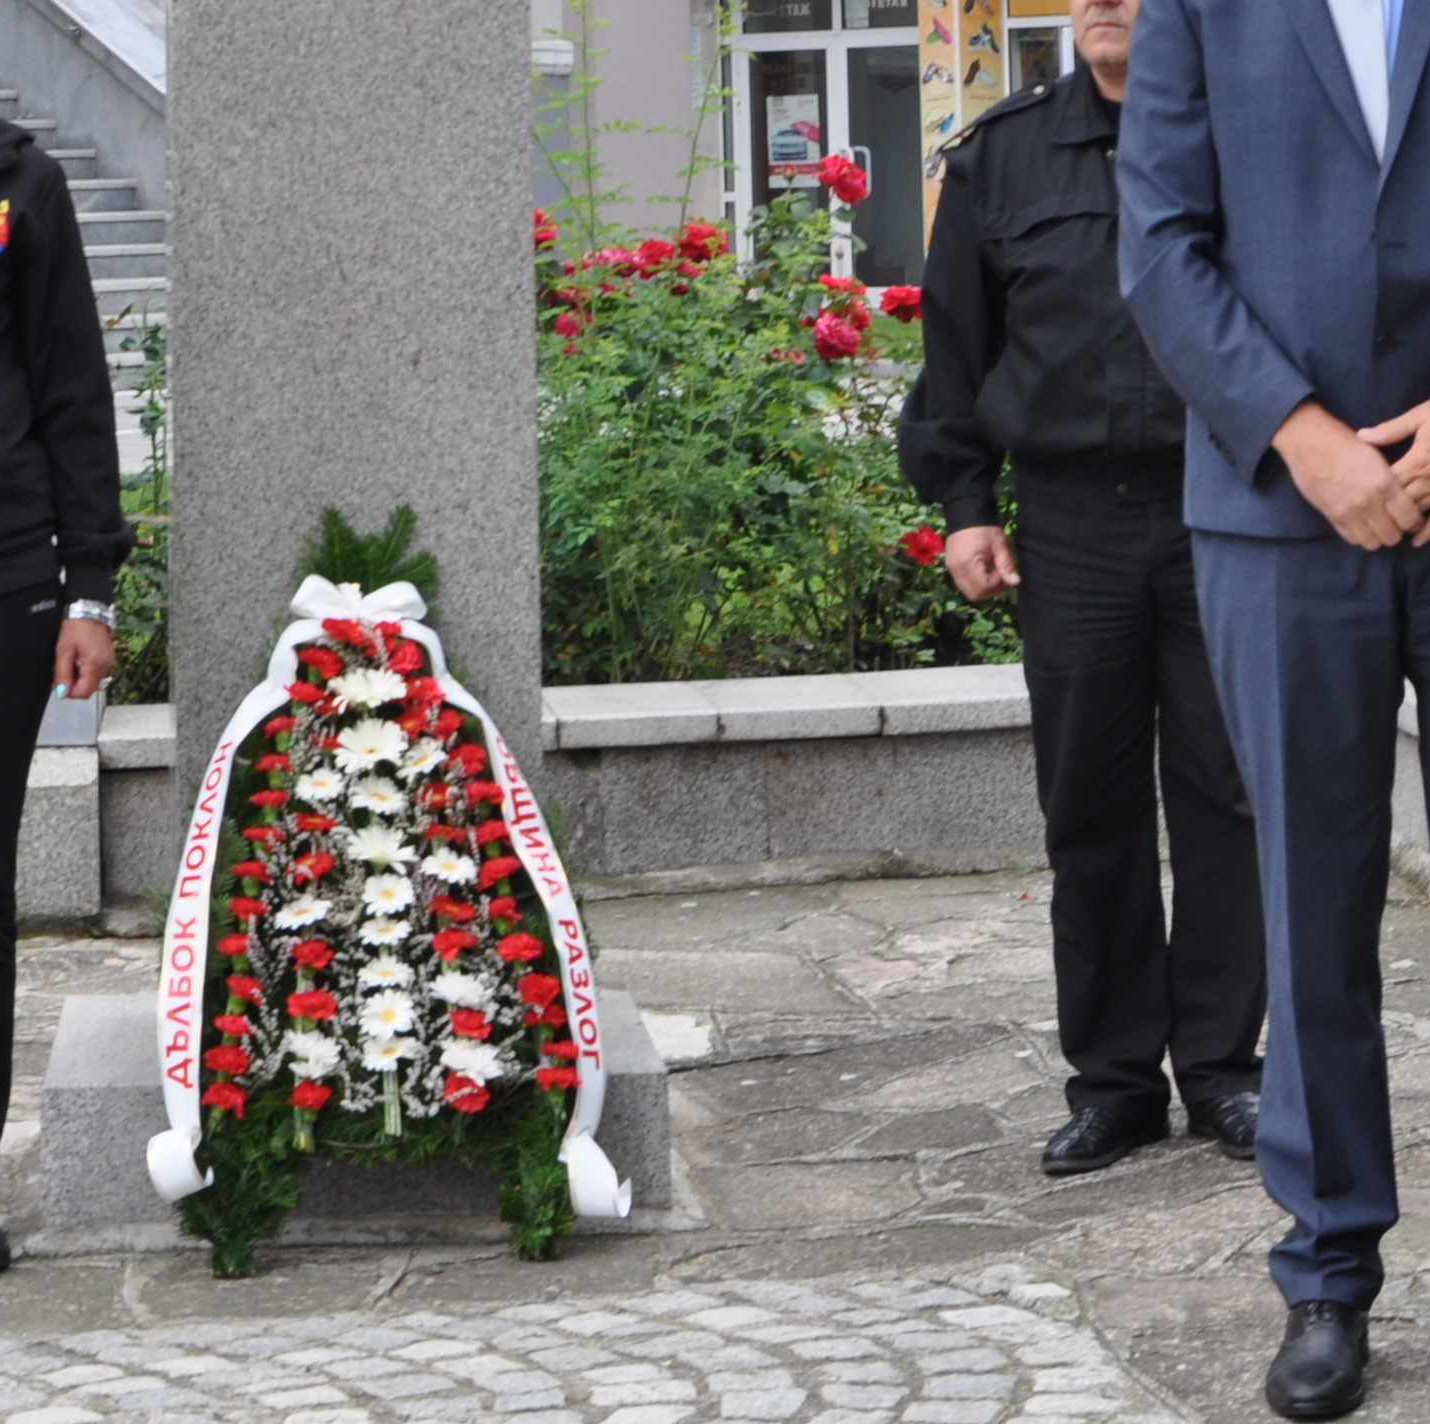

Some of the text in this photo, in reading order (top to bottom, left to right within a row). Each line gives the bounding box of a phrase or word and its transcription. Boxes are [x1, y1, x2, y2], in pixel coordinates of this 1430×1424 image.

[165, 742, 233, 1088] ДЪЛБОК ПОКЛОН
[558, 919, 600, 1070] РАЗЛОГ
